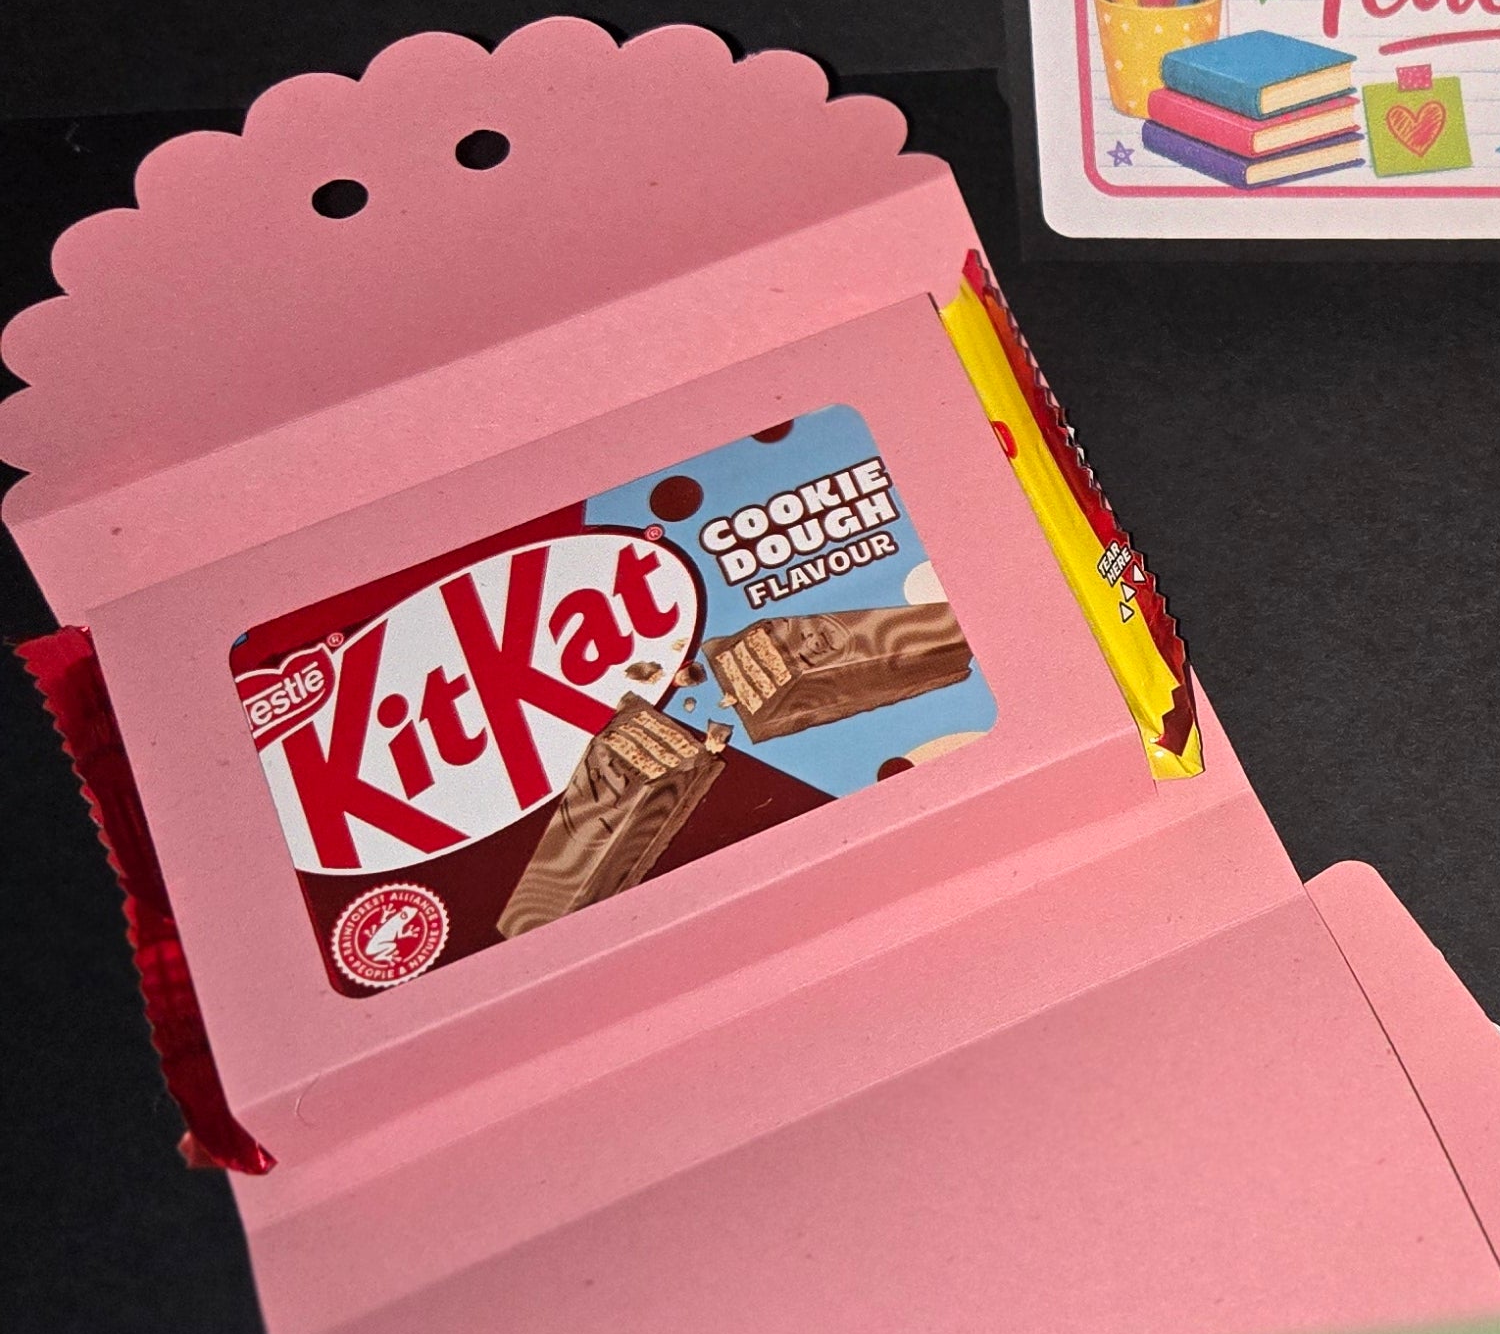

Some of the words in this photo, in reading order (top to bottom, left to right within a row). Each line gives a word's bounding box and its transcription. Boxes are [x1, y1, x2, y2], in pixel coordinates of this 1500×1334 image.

[702, 460, 889, 552] COOKIE
[719, 491, 898, 583] DOUGH
[748, 534, 896, 606] FLAVOUR
[1098, 542, 1121, 576] TEAR
[1107, 547, 1132, 585] HERE
[243, 661, 325, 731] estlé
[281, 543, 681, 869] KitKat
[342, 895, 385, 956] RAINFOREST
[389, 892, 439, 921] ALLIANCE
[351, 960, 395, 980] PEOPLE
[408, 929, 440, 970] NATURE
